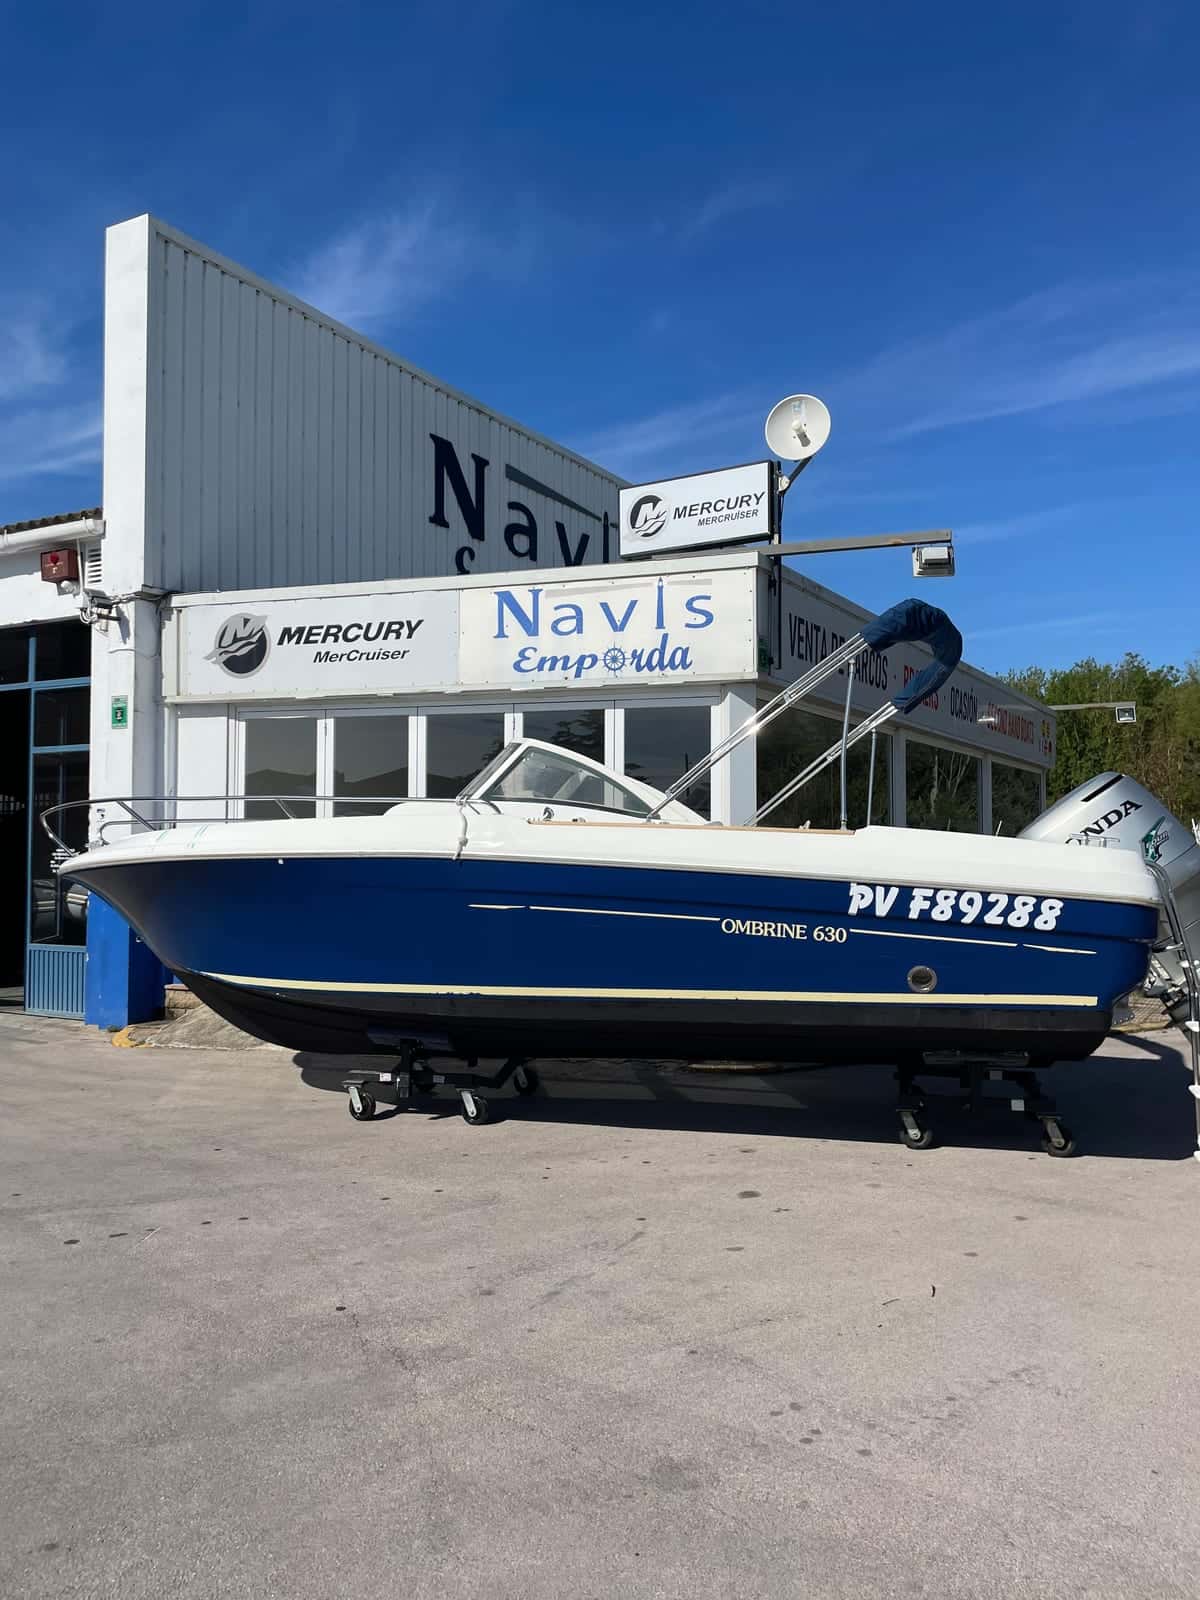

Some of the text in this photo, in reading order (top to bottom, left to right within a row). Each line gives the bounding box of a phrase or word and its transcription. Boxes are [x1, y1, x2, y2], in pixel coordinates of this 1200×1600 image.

[673, 491, 765, 520] MERCURY
[697, 508, 759, 526] MERCRUISER
[277, 619, 424, 646] MERCURY
[313, 648, 410, 664] MerCruiser
[788, 612, 828, 665] VENTA
[847, 648, 888, 690] ARCOS
[847, 882, 1064, 931] PV F89288
[721, 918, 847, 943] OMBRINE 630
